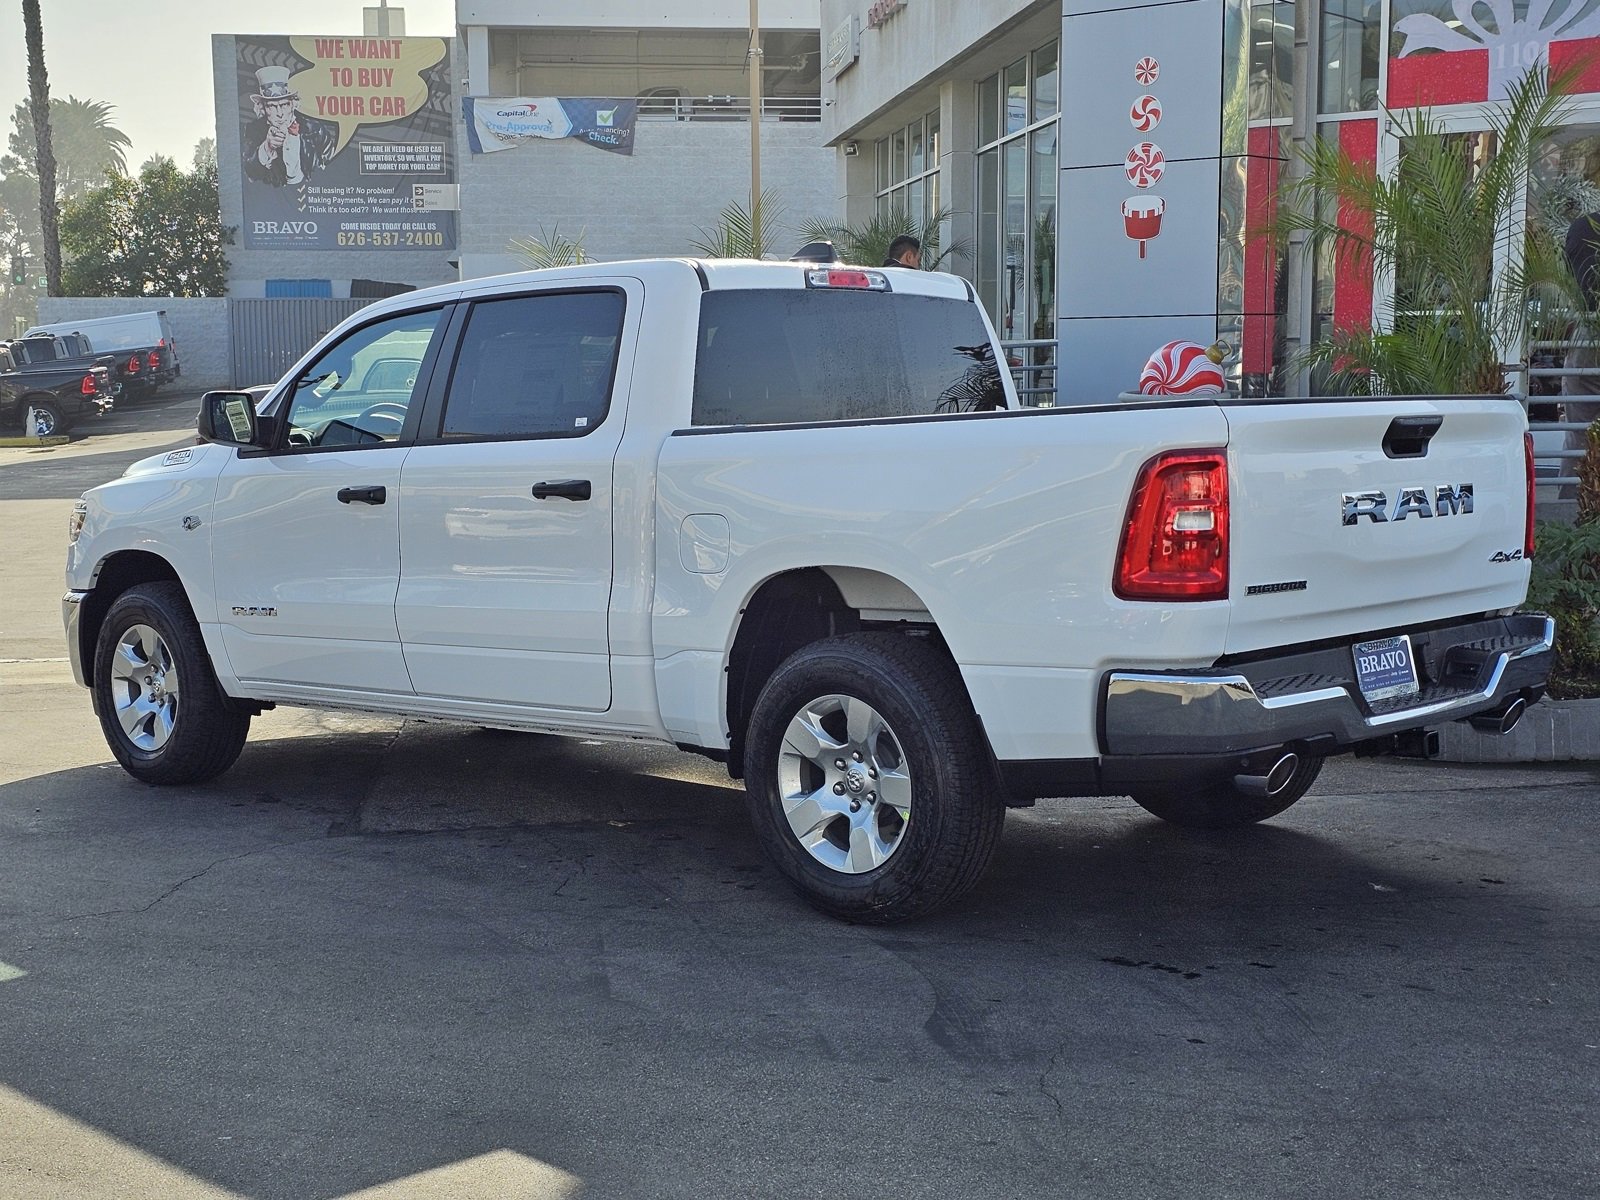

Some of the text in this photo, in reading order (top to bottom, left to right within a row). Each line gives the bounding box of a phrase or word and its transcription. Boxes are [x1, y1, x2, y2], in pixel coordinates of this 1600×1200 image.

[315, 39, 402, 59] WE WANT
[330, 68, 394, 88] TO BUY
[315, 96, 406, 116] YOUR CAR
[588, 131, 619, 145] Check.
[364, 154, 441, 162] INVENTORY, SO WE WILL PAY
[322, 187, 345, 196] leasing
[366, 187, 394, 196] problem!
[332, 197, 365, 205] Payments,
[252, 221, 318, 234] BRAVO
[337, 232, 443, 246] 626-537-2400
[1341, 483, 1474, 526] RAM
[1489, 549, 1522, 563] 4x4
[232, 606, 278, 616] RAM
[1359, 650, 1406, 674] BRAVO
